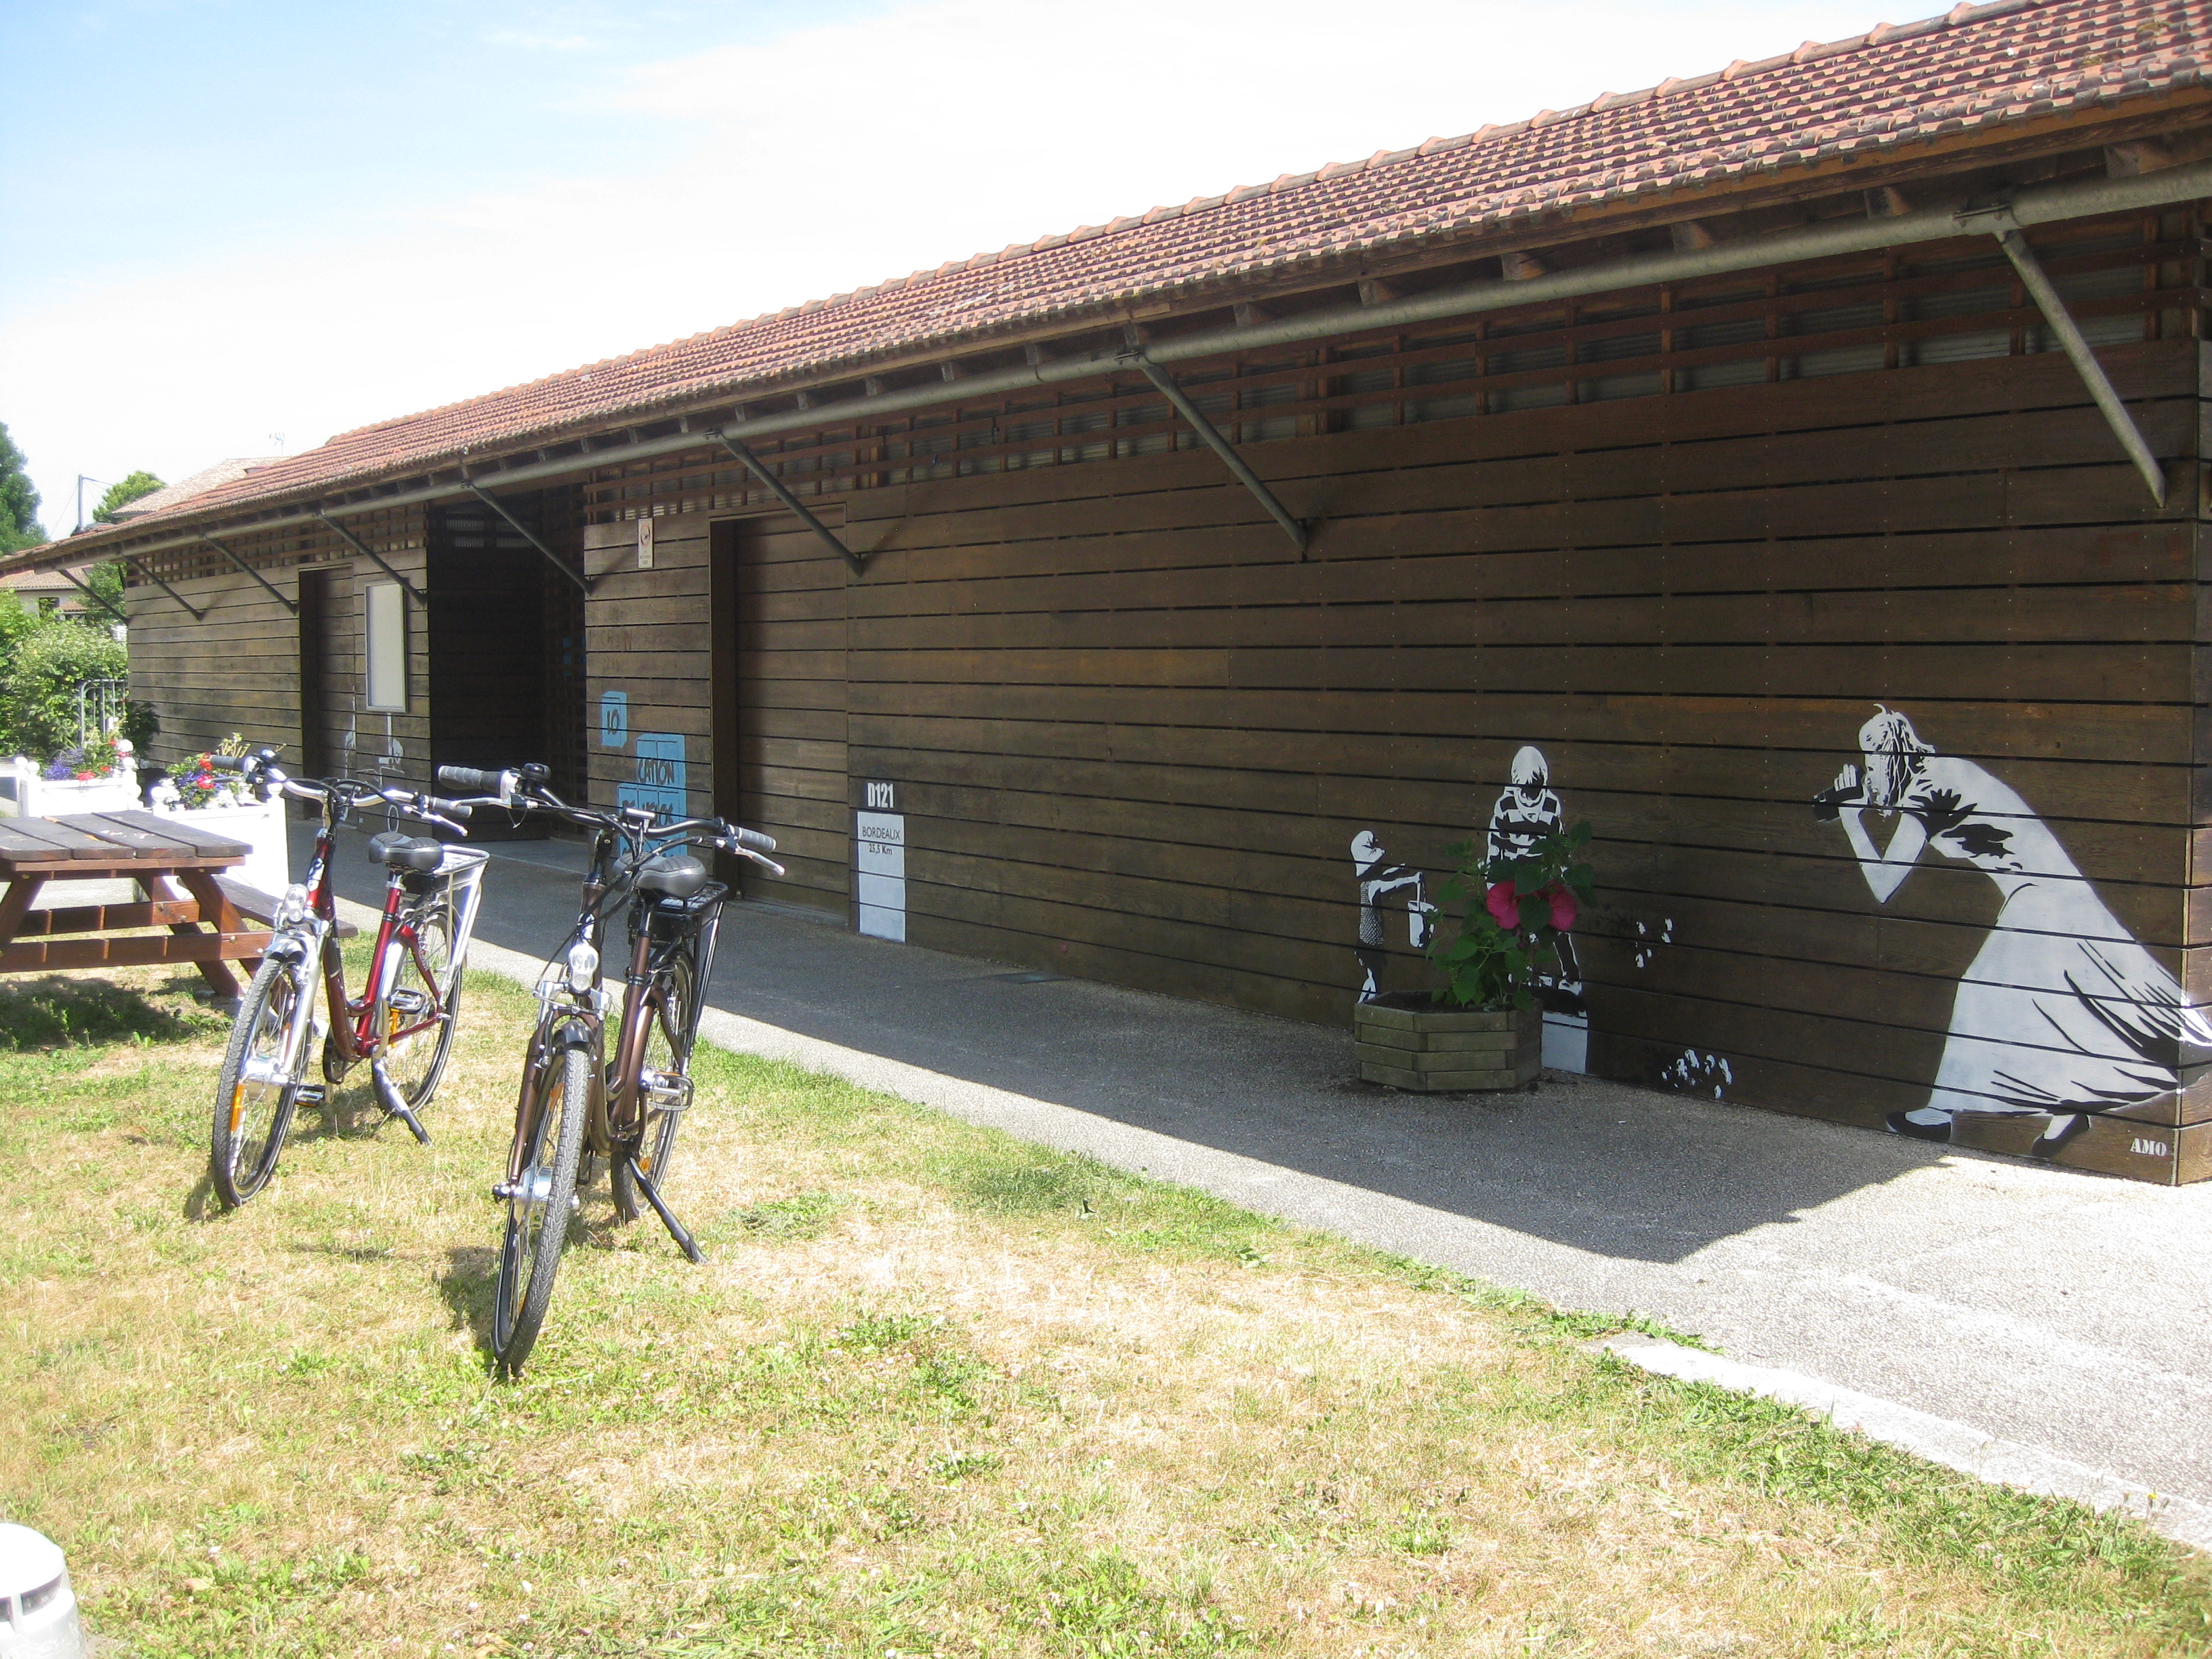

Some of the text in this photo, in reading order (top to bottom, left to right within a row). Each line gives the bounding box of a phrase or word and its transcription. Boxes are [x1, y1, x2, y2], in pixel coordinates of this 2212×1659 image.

[867, 782, 895, 808] D121
[862, 825, 901, 840] BORDEAUX
[2129, 1137, 2167, 1157] AMO
